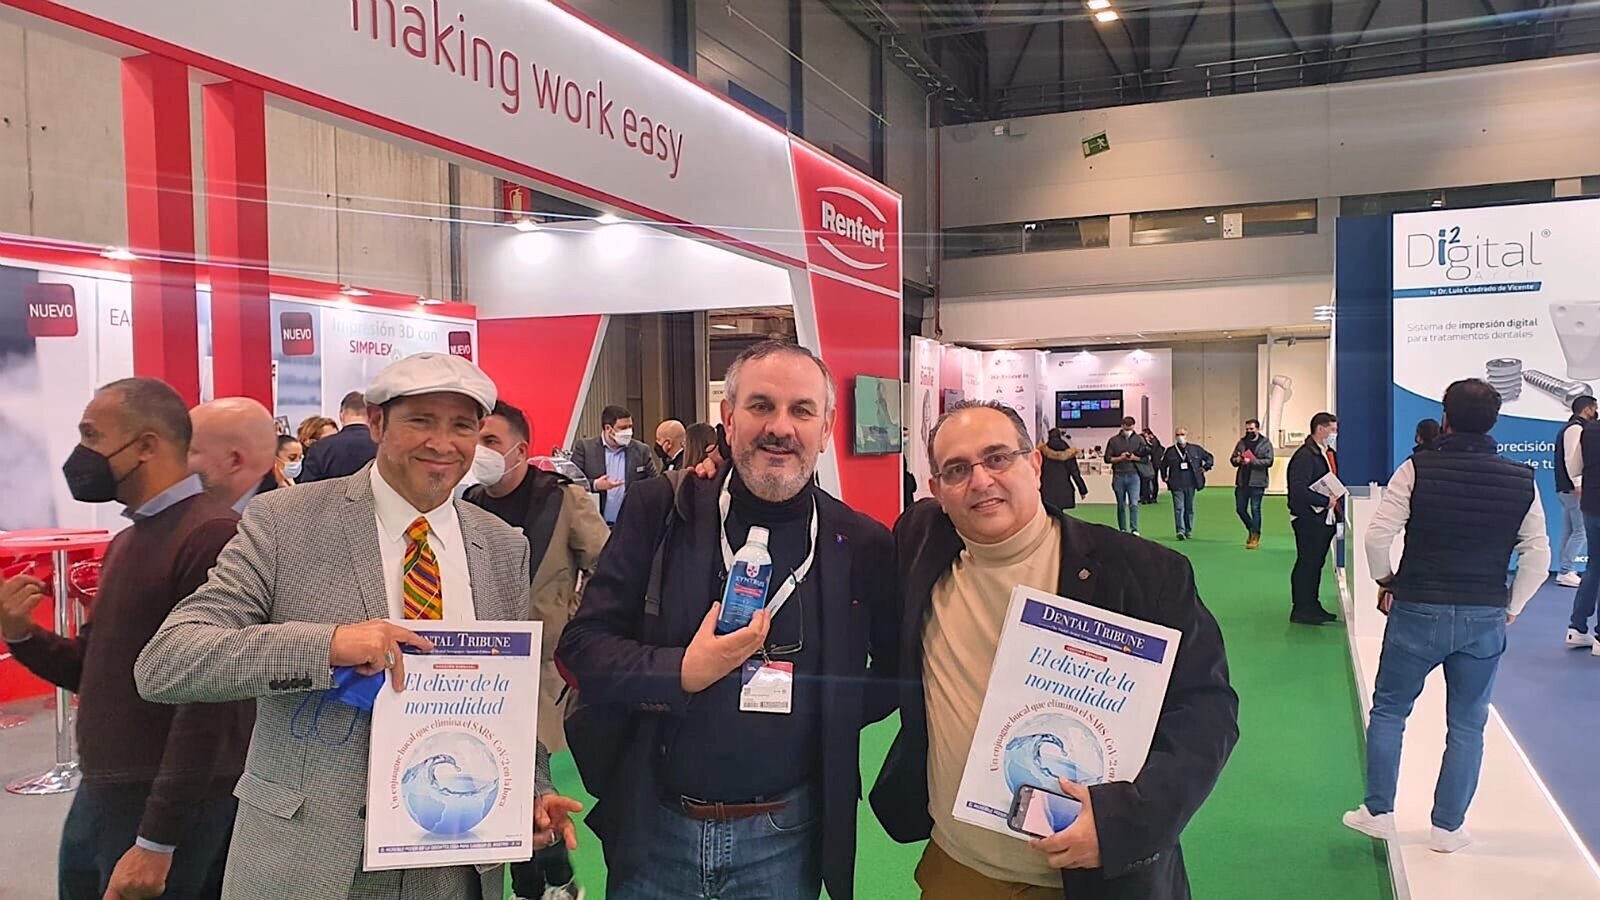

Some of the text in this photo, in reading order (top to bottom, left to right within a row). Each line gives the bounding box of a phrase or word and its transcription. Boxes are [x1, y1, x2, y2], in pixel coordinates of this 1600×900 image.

[351, 0, 683, 179] making work easy
[822, 200, 885, 252] Renfert
[1438, 287, 1448, 295] Dr.
[1449, 286, 1463, 294] Luis
[1464, 285, 1497, 293] Cuadrado
[1508, 283, 1535, 291] Vicente
[29, 303, 73, 318] NUEVO
[110, 308, 131, 327] EA
[1407, 318, 1538, 332] Sistema de impresión digital
[282, 328, 312, 341] NUEVO
[399, 324, 414, 339] 3D
[418, 329, 438, 342] con
[1407, 331, 1534, 343] para tratamientos dentales
[450, 344, 471, 355] NUEVO
[1496, 440, 1555, 453] precisión
[1042, 606, 1090, 632] DENTAL
[1093, 621, 1145, 650] TRIBUNE
[423, 633, 511, 648] NTAL TRIBUNE
[1029, 646, 1052, 667] El
[1049, 655, 1095, 679] elixir
[1094, 668, 1117, 687] de
[1117, 672, 1136, 693] la
[405, 673, 510, 692] El elixir de la
[1024, 673, 1127, 714] normalidad
[404, 697, 504, 715] normalidad
[1031, 702, 1046, 712] que
[1047, 699, 1078, 713] elimina
[1008, 705, 1031, 723] bucal
[1078, 709, 1089, 718] el
[430, 717, 461, 729] elimina
[462, 720, 471, 728] el
[415, 725, 429, 737] que
[397, 733, 416, 755] bucal
[993, 722, 1012, 757] enjuague
[503, 767, 510, 777] en
[990, 758, 999, 772] Un
[1108, 767, 1115, 778] en
[504, 778, 512, 786] la
[392, 795, 400, 809] Un
[499, 787, 512, 807] boca
